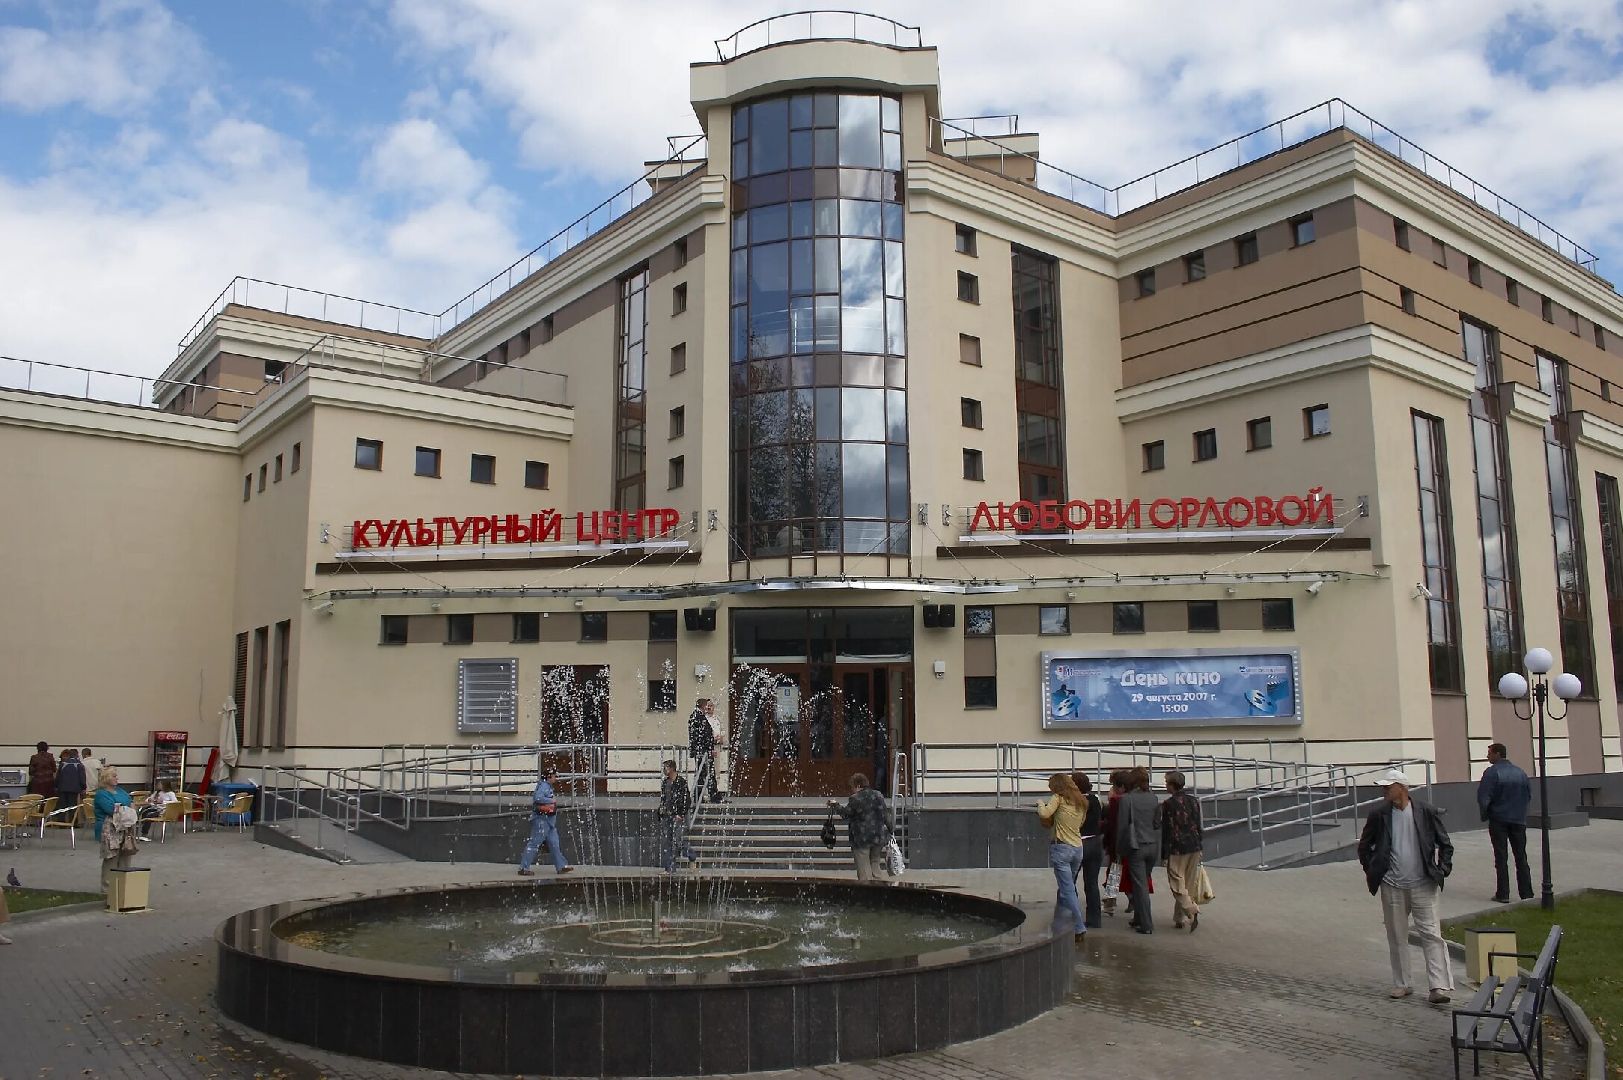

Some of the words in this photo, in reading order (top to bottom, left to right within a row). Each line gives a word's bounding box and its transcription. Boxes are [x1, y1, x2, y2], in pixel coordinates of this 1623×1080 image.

[969, 498, 1142, 532] ЛЮБОВИ
[1149, 486, 1334, 529] ОРЛОВОЙ
[353, 508, 562, 547] КУЛЬТУРНЫЙ
[577, 508, 680, 545] ЦЕНТР
[1120, 669, 1168, 687] День
[1175, 671, 1221, 687] кино
[1131, 693, 1144, 703] 29
[1183, 692, 1208, 701] 2007
[1160, 704, 1189, 713] 15:00
